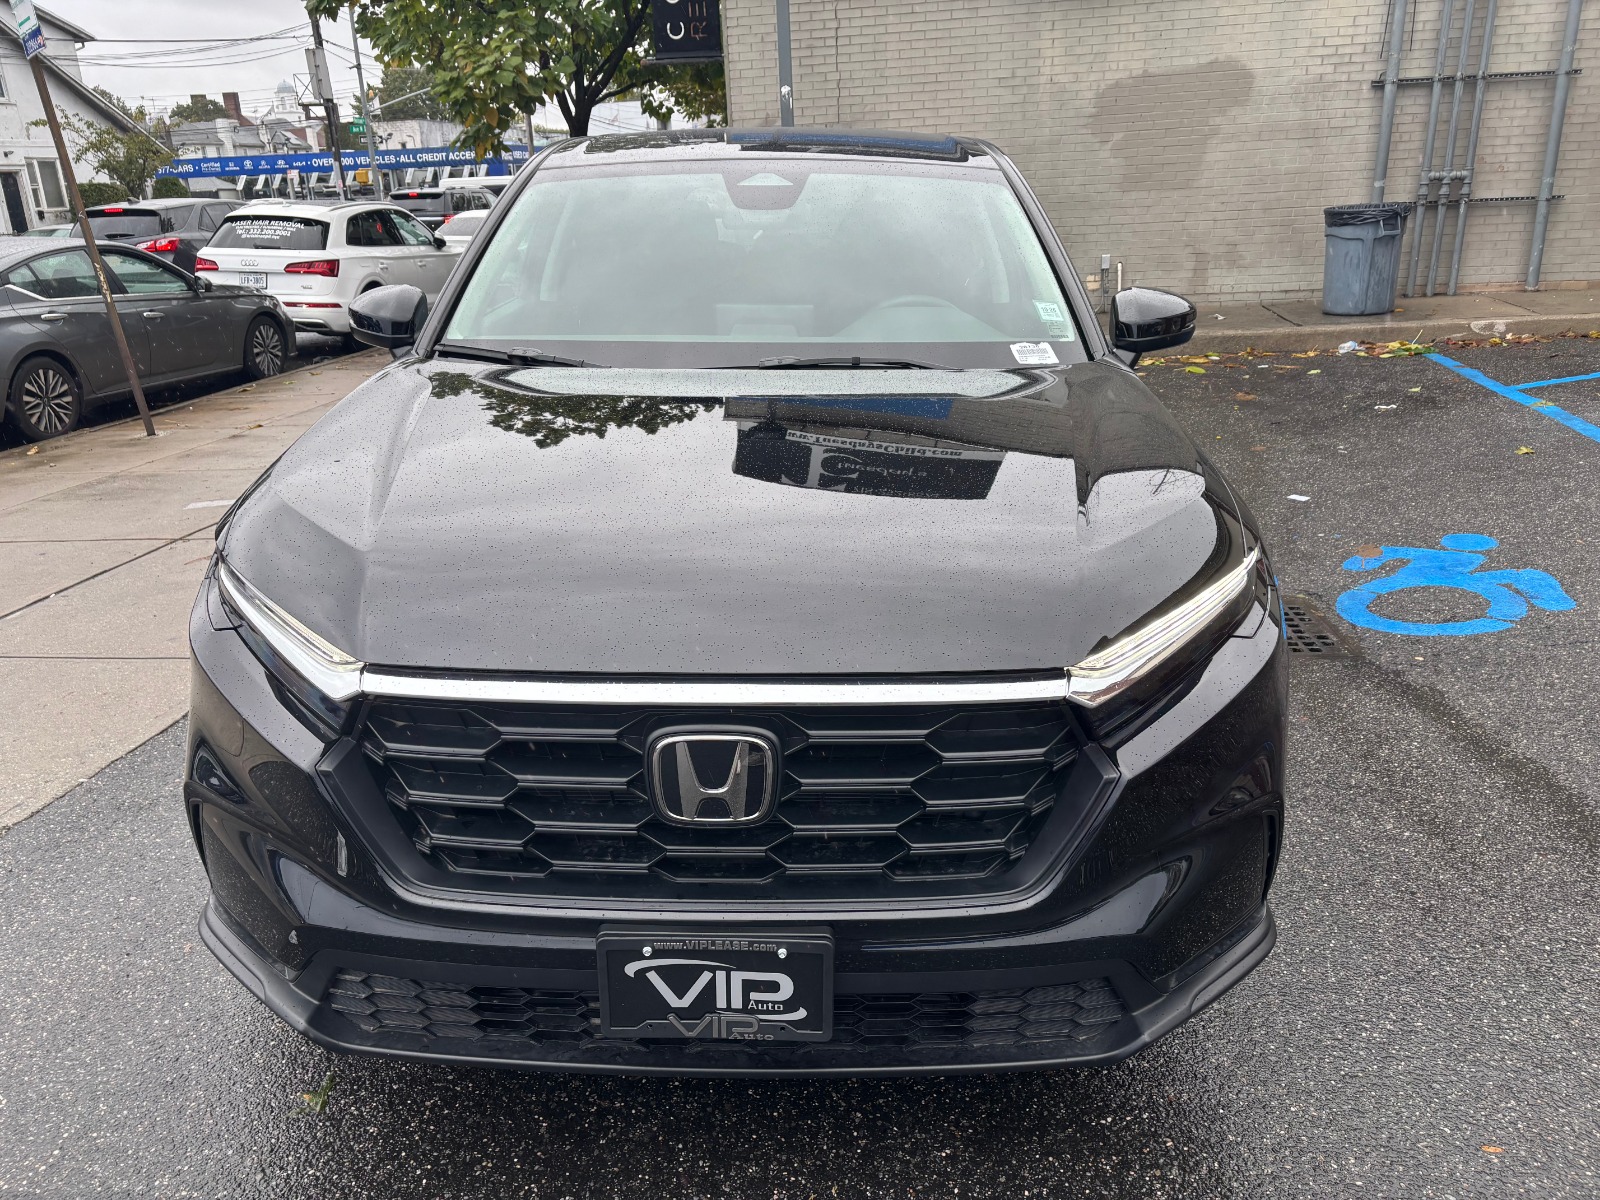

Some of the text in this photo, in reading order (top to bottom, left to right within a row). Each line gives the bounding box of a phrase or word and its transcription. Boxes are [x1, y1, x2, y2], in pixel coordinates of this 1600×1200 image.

[666, 0, 685, 40] C
[355, 154, 396, 165] VEHCLES
[418, 152, 447, 162] CREDIT
[270, 221, 304, 229] REMOVAL
[653, 940, 777, 952] www.VIPLEASE.com
[645, 970, 794, 1008] VIP
[748, 1000, 783, 1011] Auto
[668, 1014, 759, 1038] VIP
[729, 1031, 775, 1041] Auto
